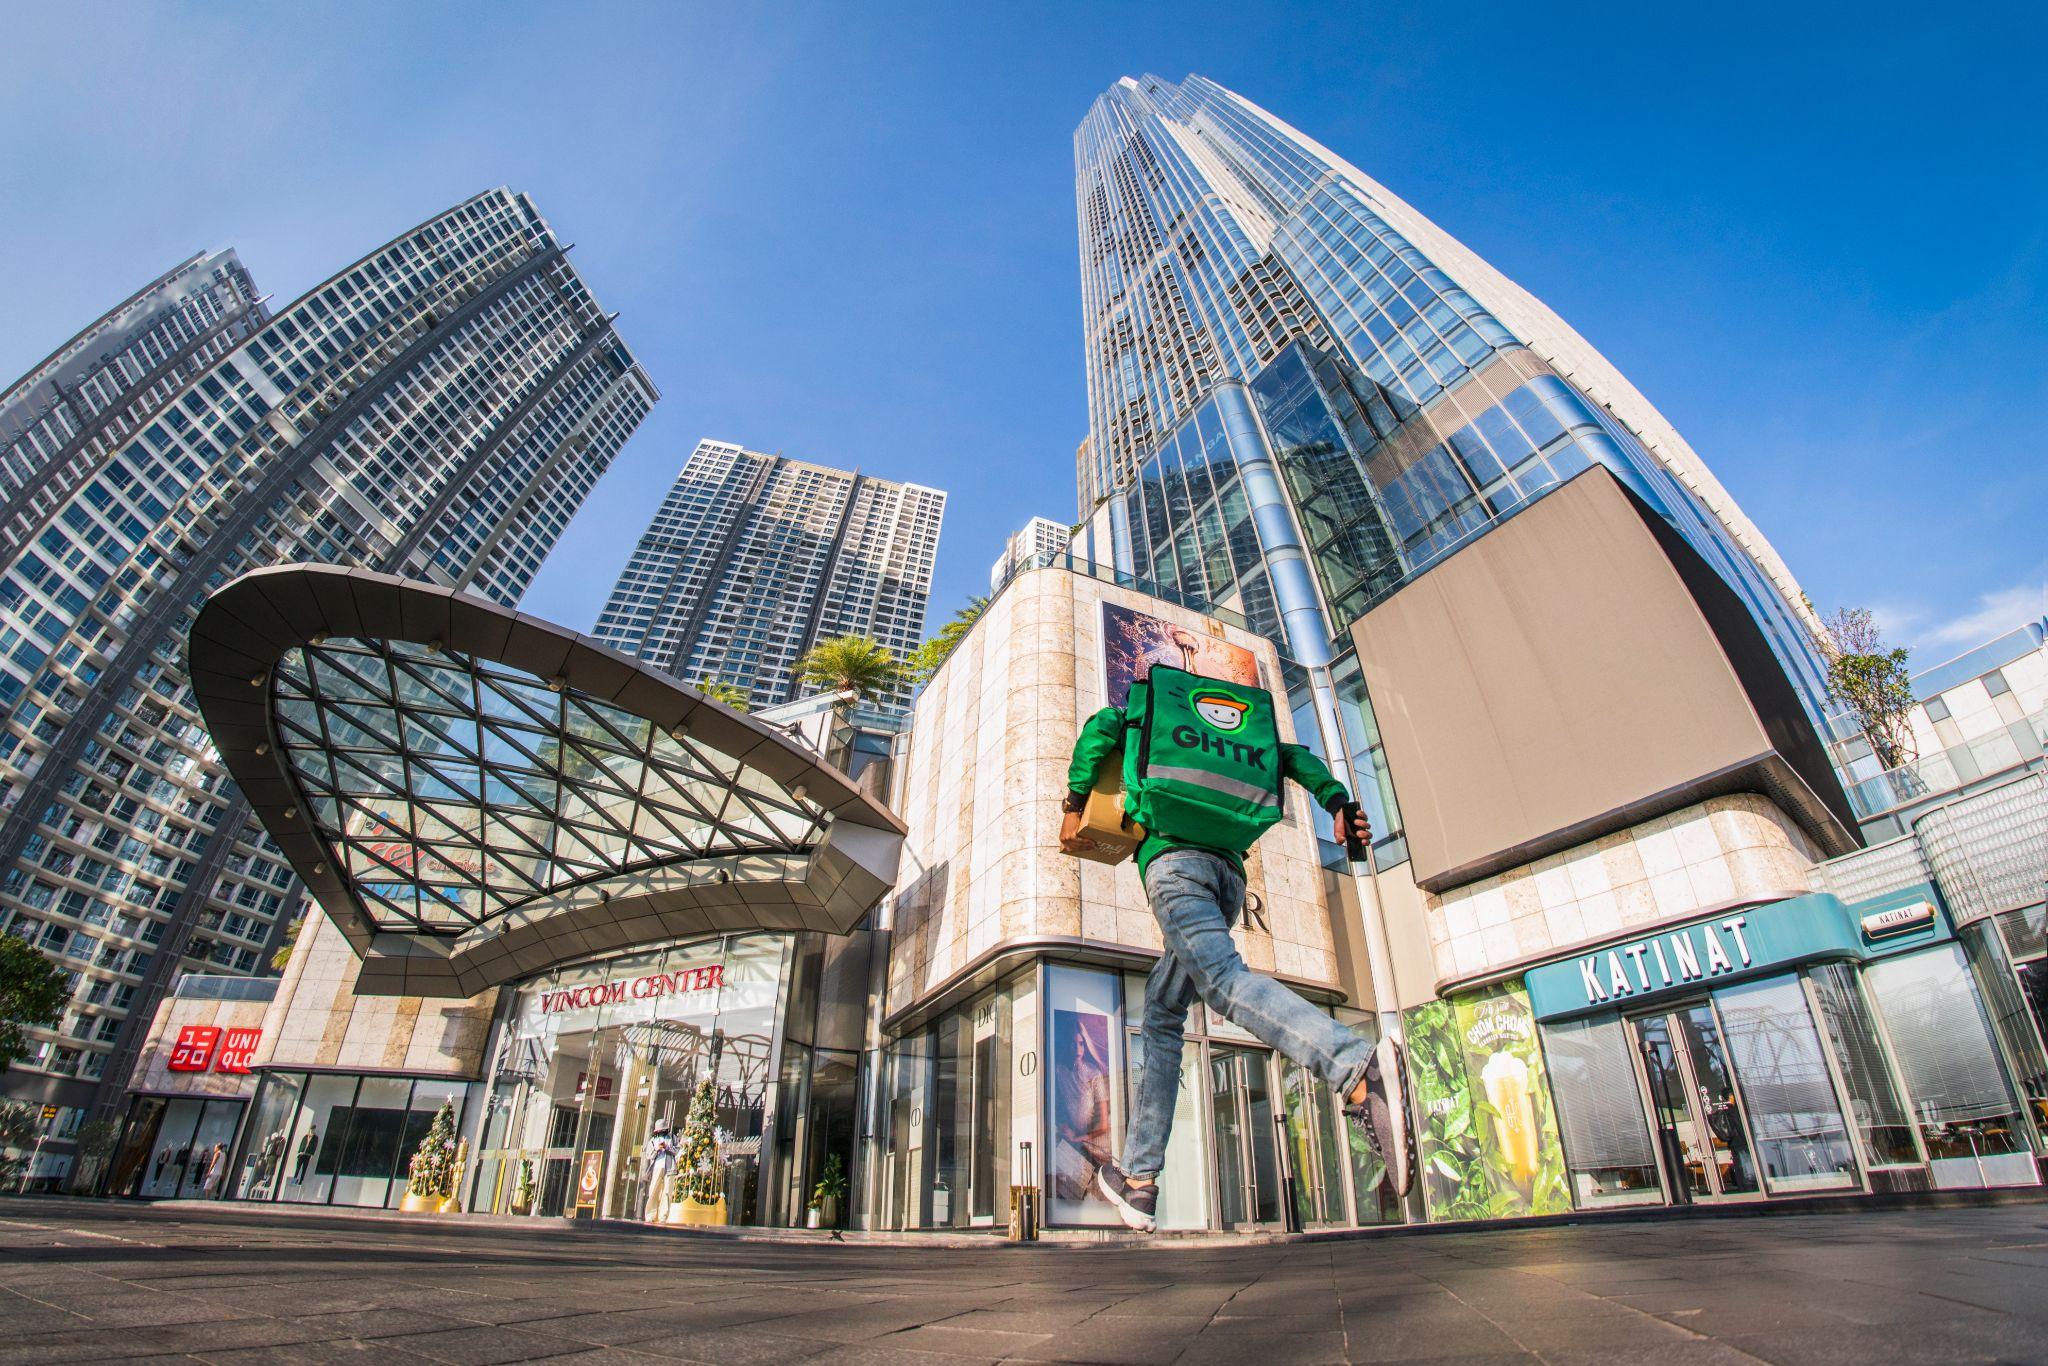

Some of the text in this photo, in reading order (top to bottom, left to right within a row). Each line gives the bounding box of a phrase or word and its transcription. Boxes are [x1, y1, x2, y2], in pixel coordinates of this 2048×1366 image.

[1172, 725, 1267, 771] GHTK
[1878, 908, 1914, 924] KATINAT
[1578, 916, 1752, 1004] KATINAT
[540, 965, 725, 1014] VINCOM CENTER
[228, 1033, 260, 1050] UNI
